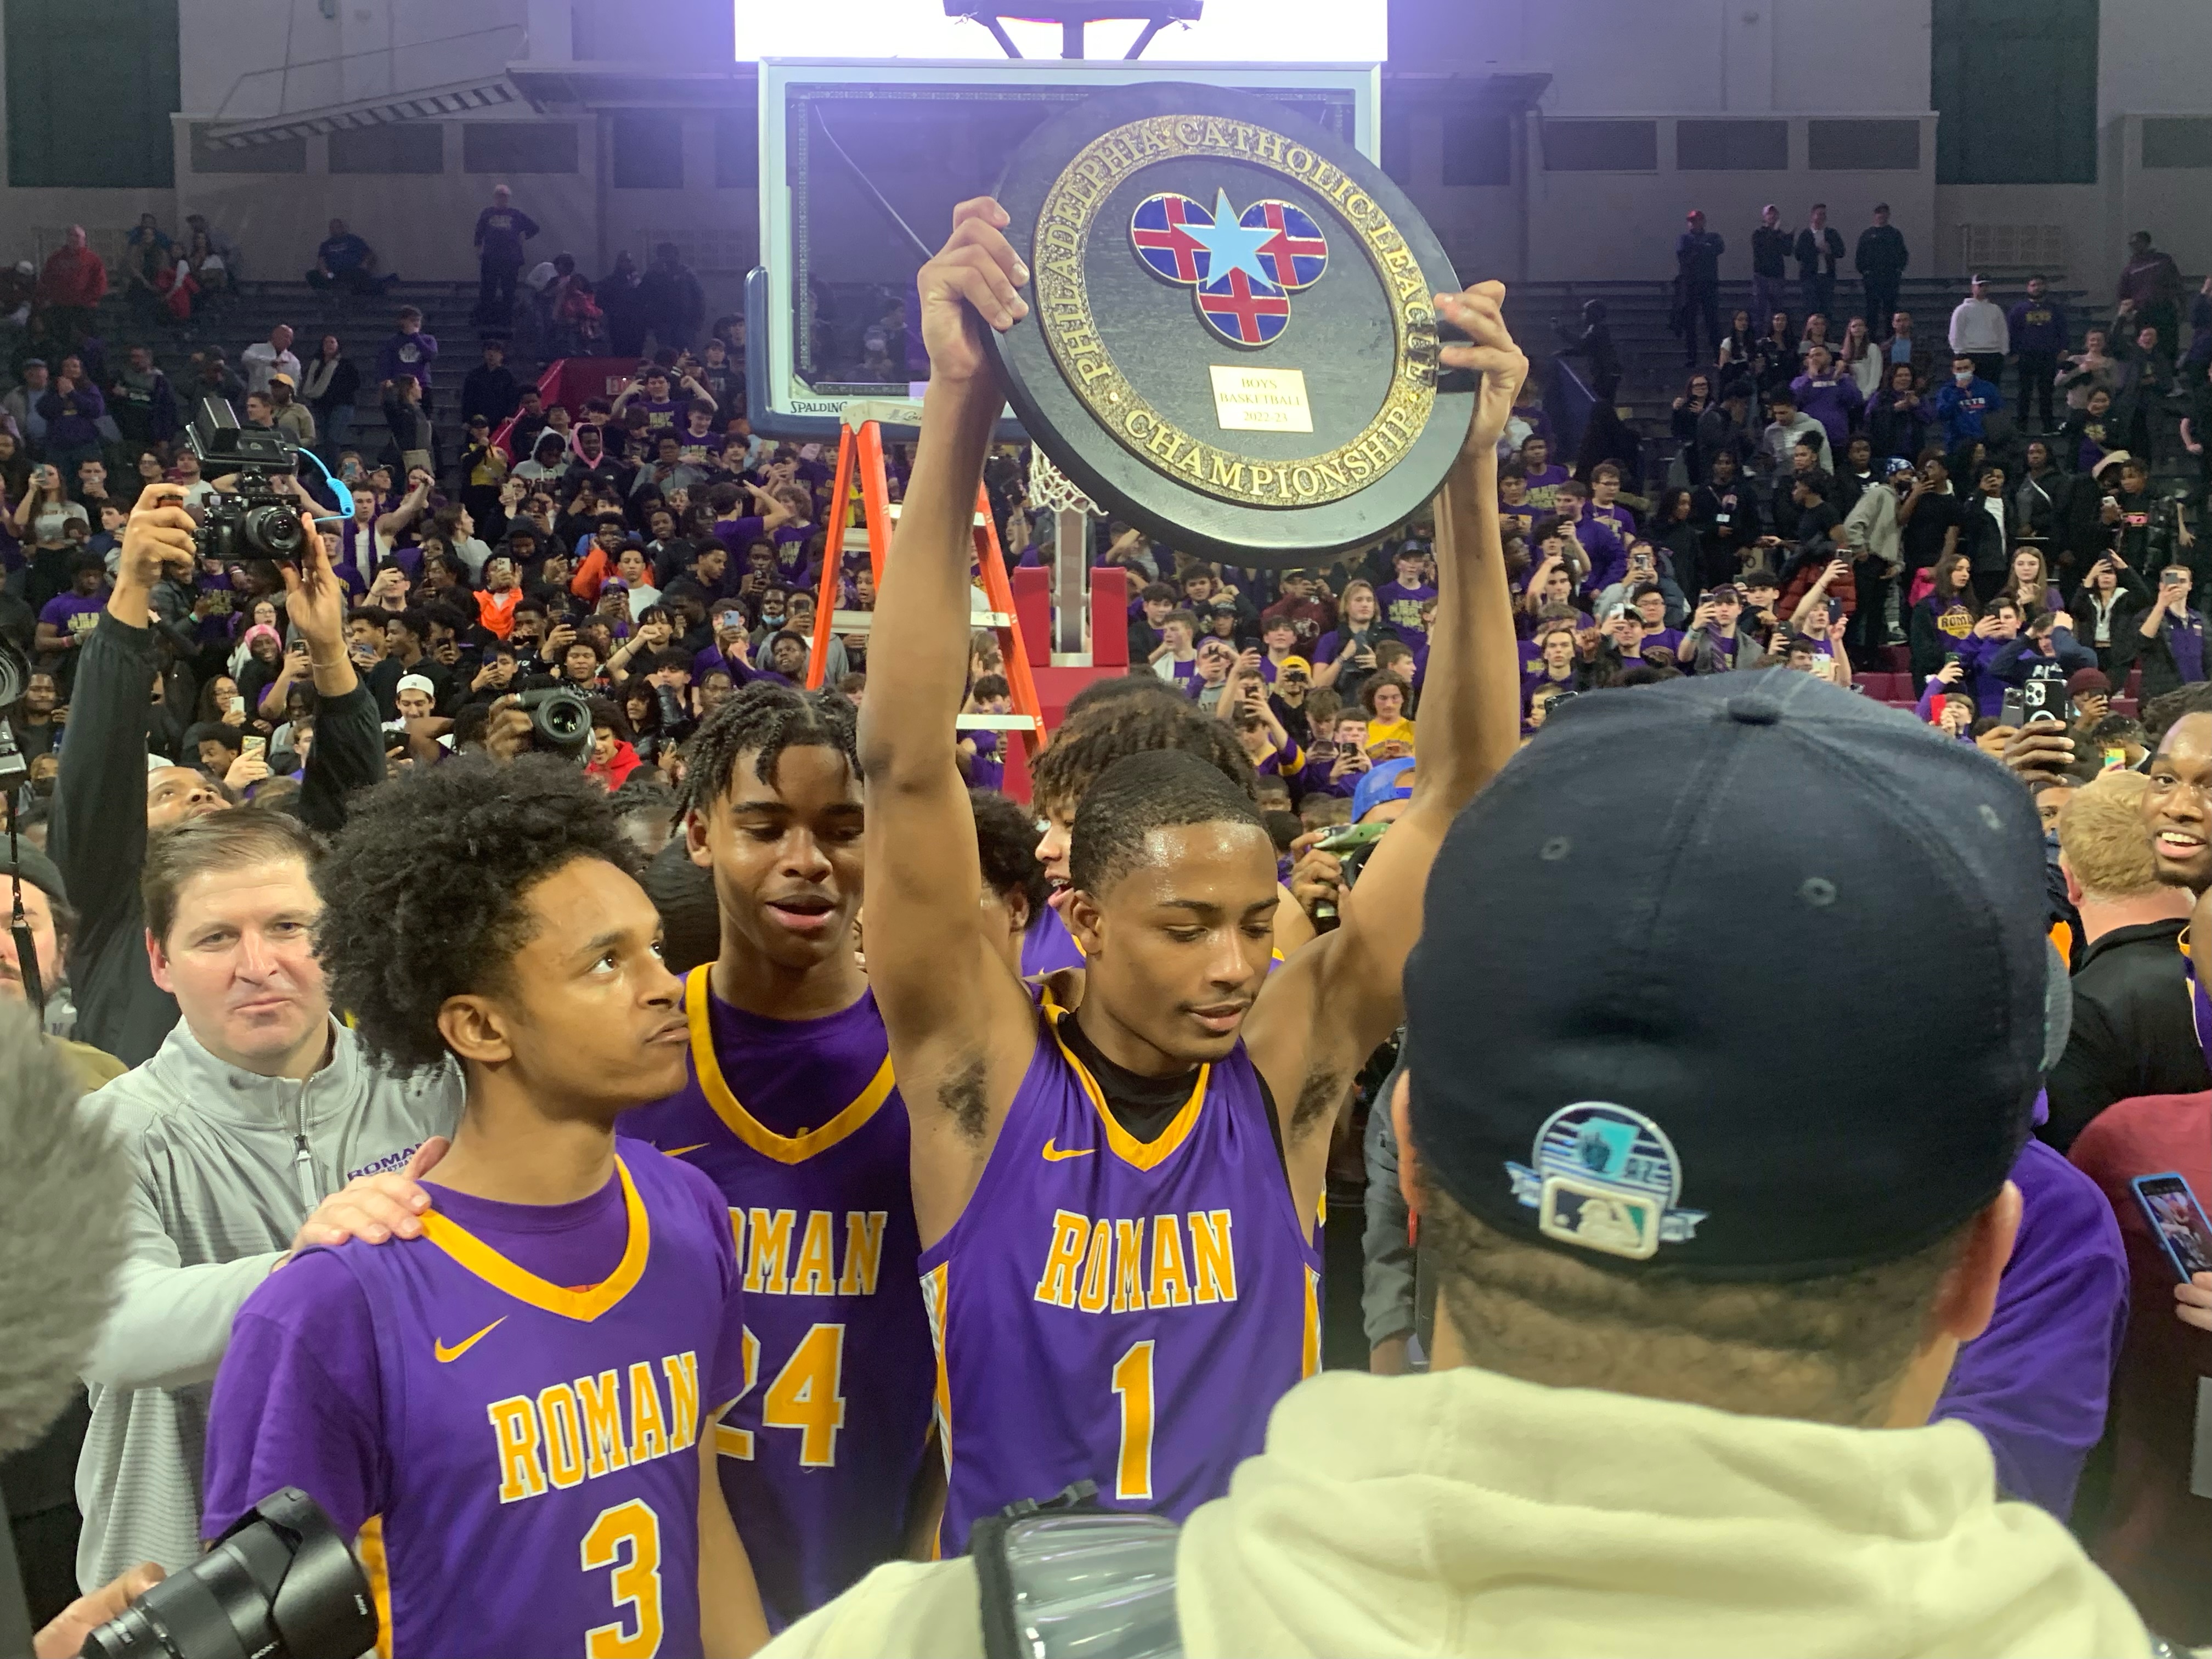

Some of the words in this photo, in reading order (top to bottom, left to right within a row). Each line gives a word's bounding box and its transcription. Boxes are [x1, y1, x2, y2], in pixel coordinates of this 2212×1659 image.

[1046, 128, 1169, 385] PHILADELPHIA
[1175, 120, 1375, 219] CATHOLIC
[1368, 222, 1436, 386] LEAGUE
[1220, 393, 1301, 405] BASKETBALL
[1242, 378, 1277, 388] BOYS
[1243, 411, 1288, 422] 2022-23
[1125, 406, 1415, 499] CHAMPIONSHIP
[727, 1206, 888, 1296] MAN
[1034, 1209, 1238, 1314] ROMAN
[487, 1350, 699, 1504] ROMAN
[1111, 1340, 1155, 1500] 1
[580, 1498, 664, 1659] 3
